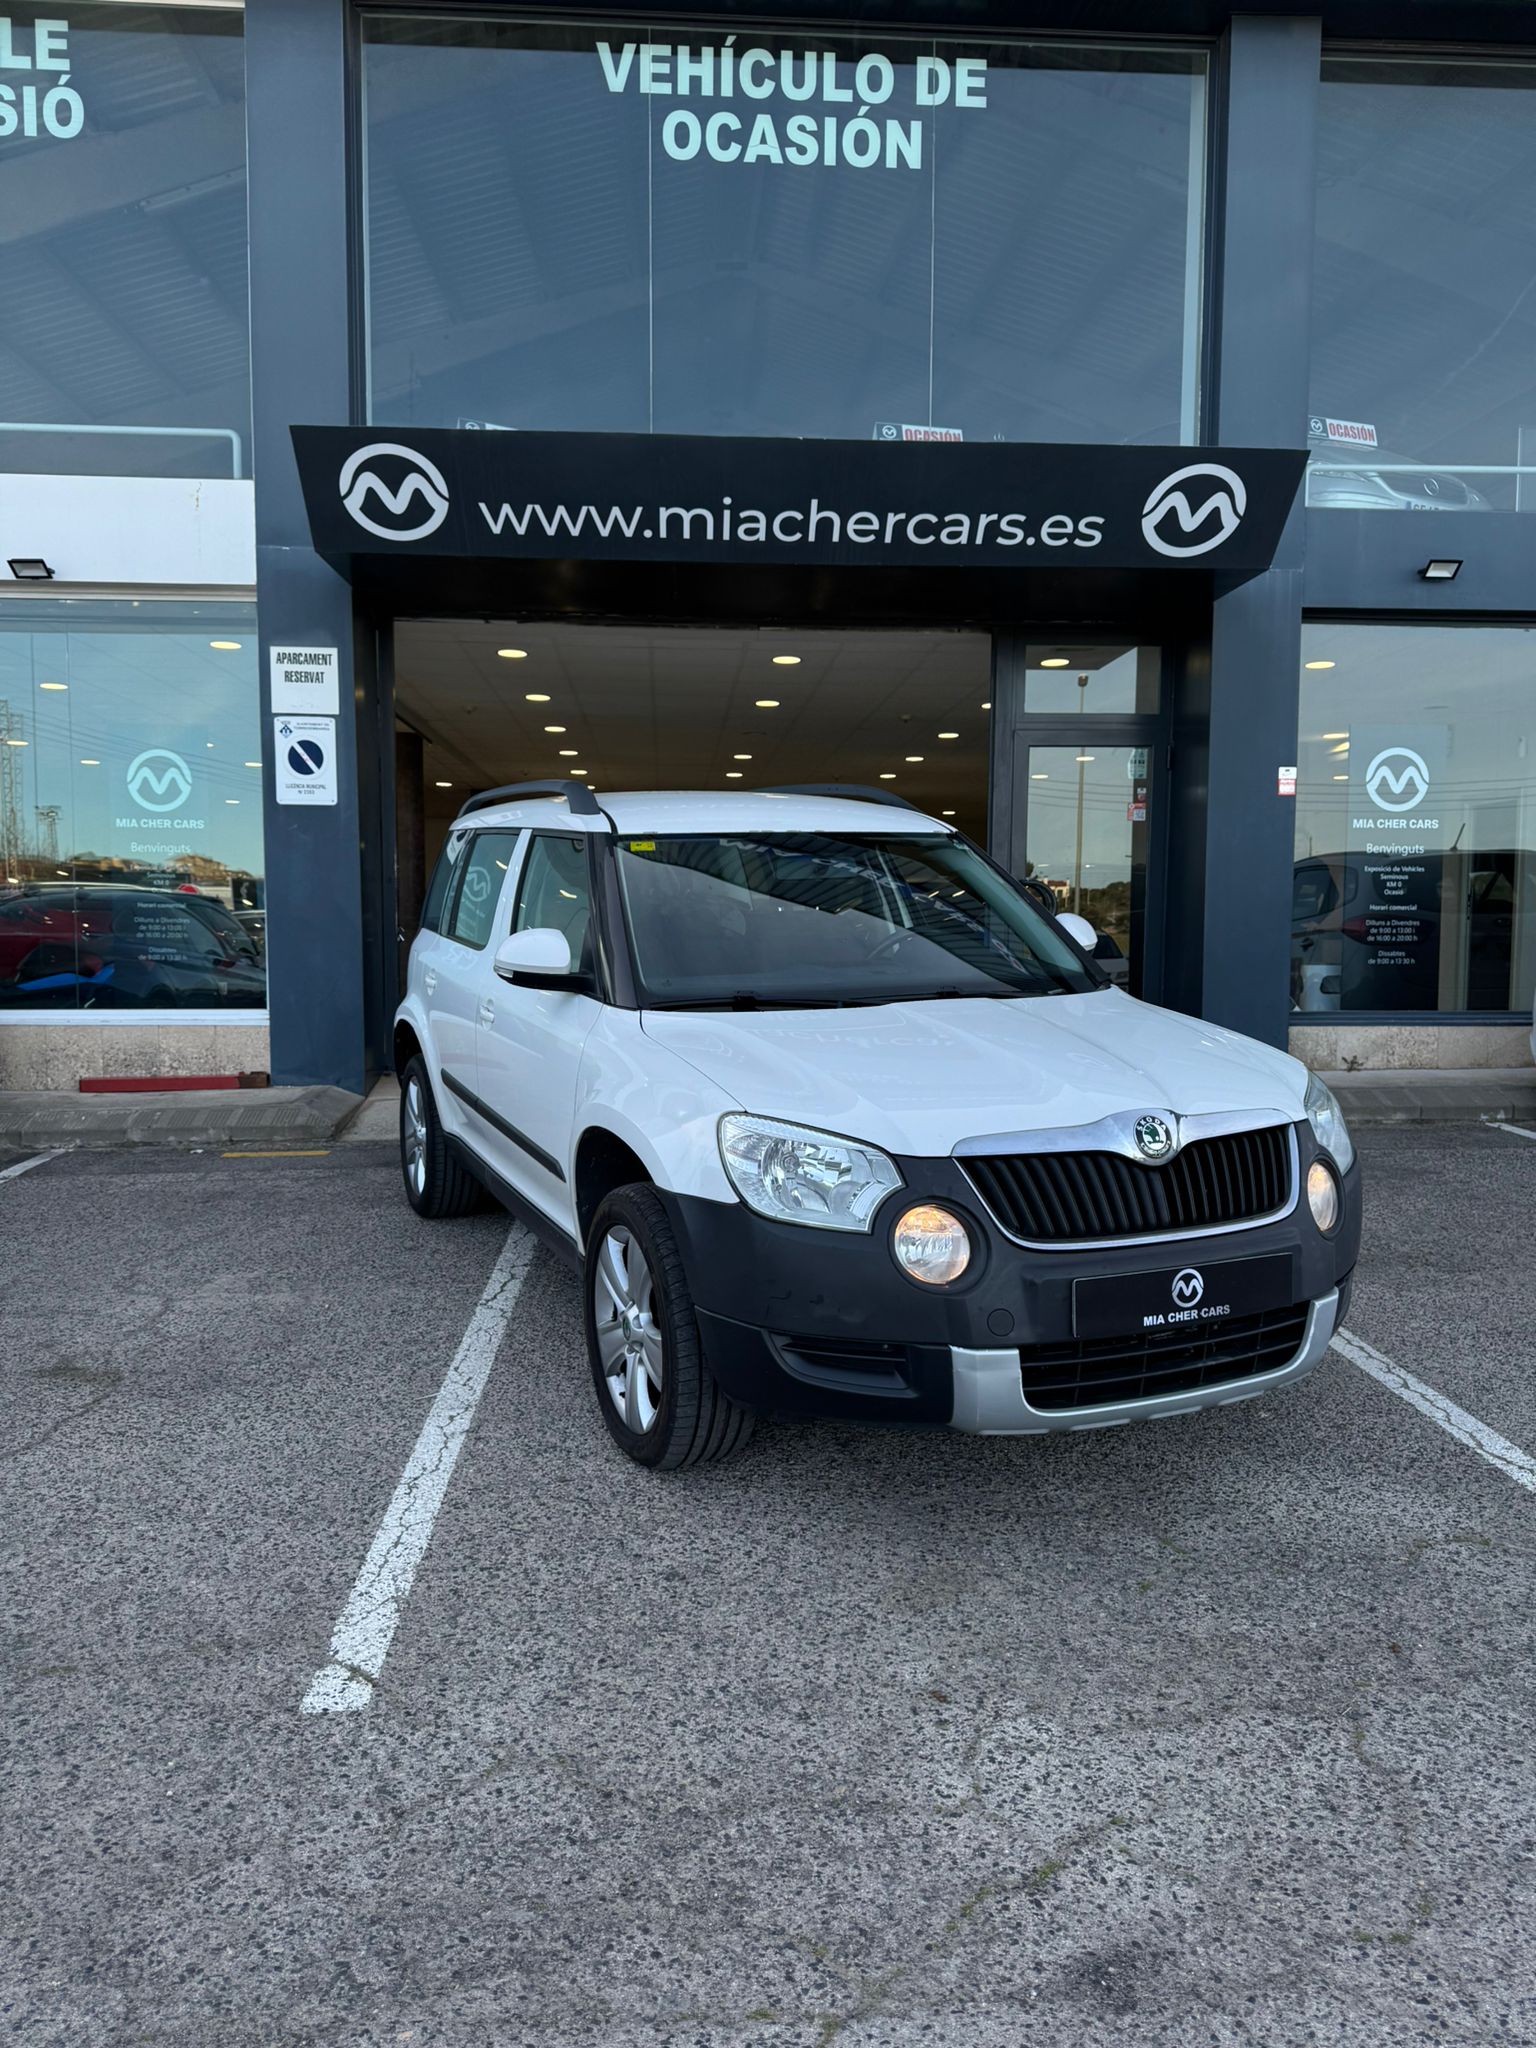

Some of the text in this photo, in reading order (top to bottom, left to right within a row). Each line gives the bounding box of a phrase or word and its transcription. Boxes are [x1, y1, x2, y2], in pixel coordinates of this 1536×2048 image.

[596, 35, 988, 108] VEHÍCULO DE
[662, 106, 923, 169] OCASIÓN
[1328, 422, 1376, 442] OCASIÓN
[478, 497, 1106, 548] www.miachercars.es
[276, 652, 333, 666] APARCAMENT
[284, 670, 325, 684] RESERVAT
[116, 818, 205, 829] MIA CHER CARS
[1352, 818, 1439, 829] MIA CHER CARS
[130, 841, 191, 856] Benvinguts
[1366, 843, 1425, 857] Benvinguts
[1143, 1304, 1231, 1327] MIA CHER CARS
